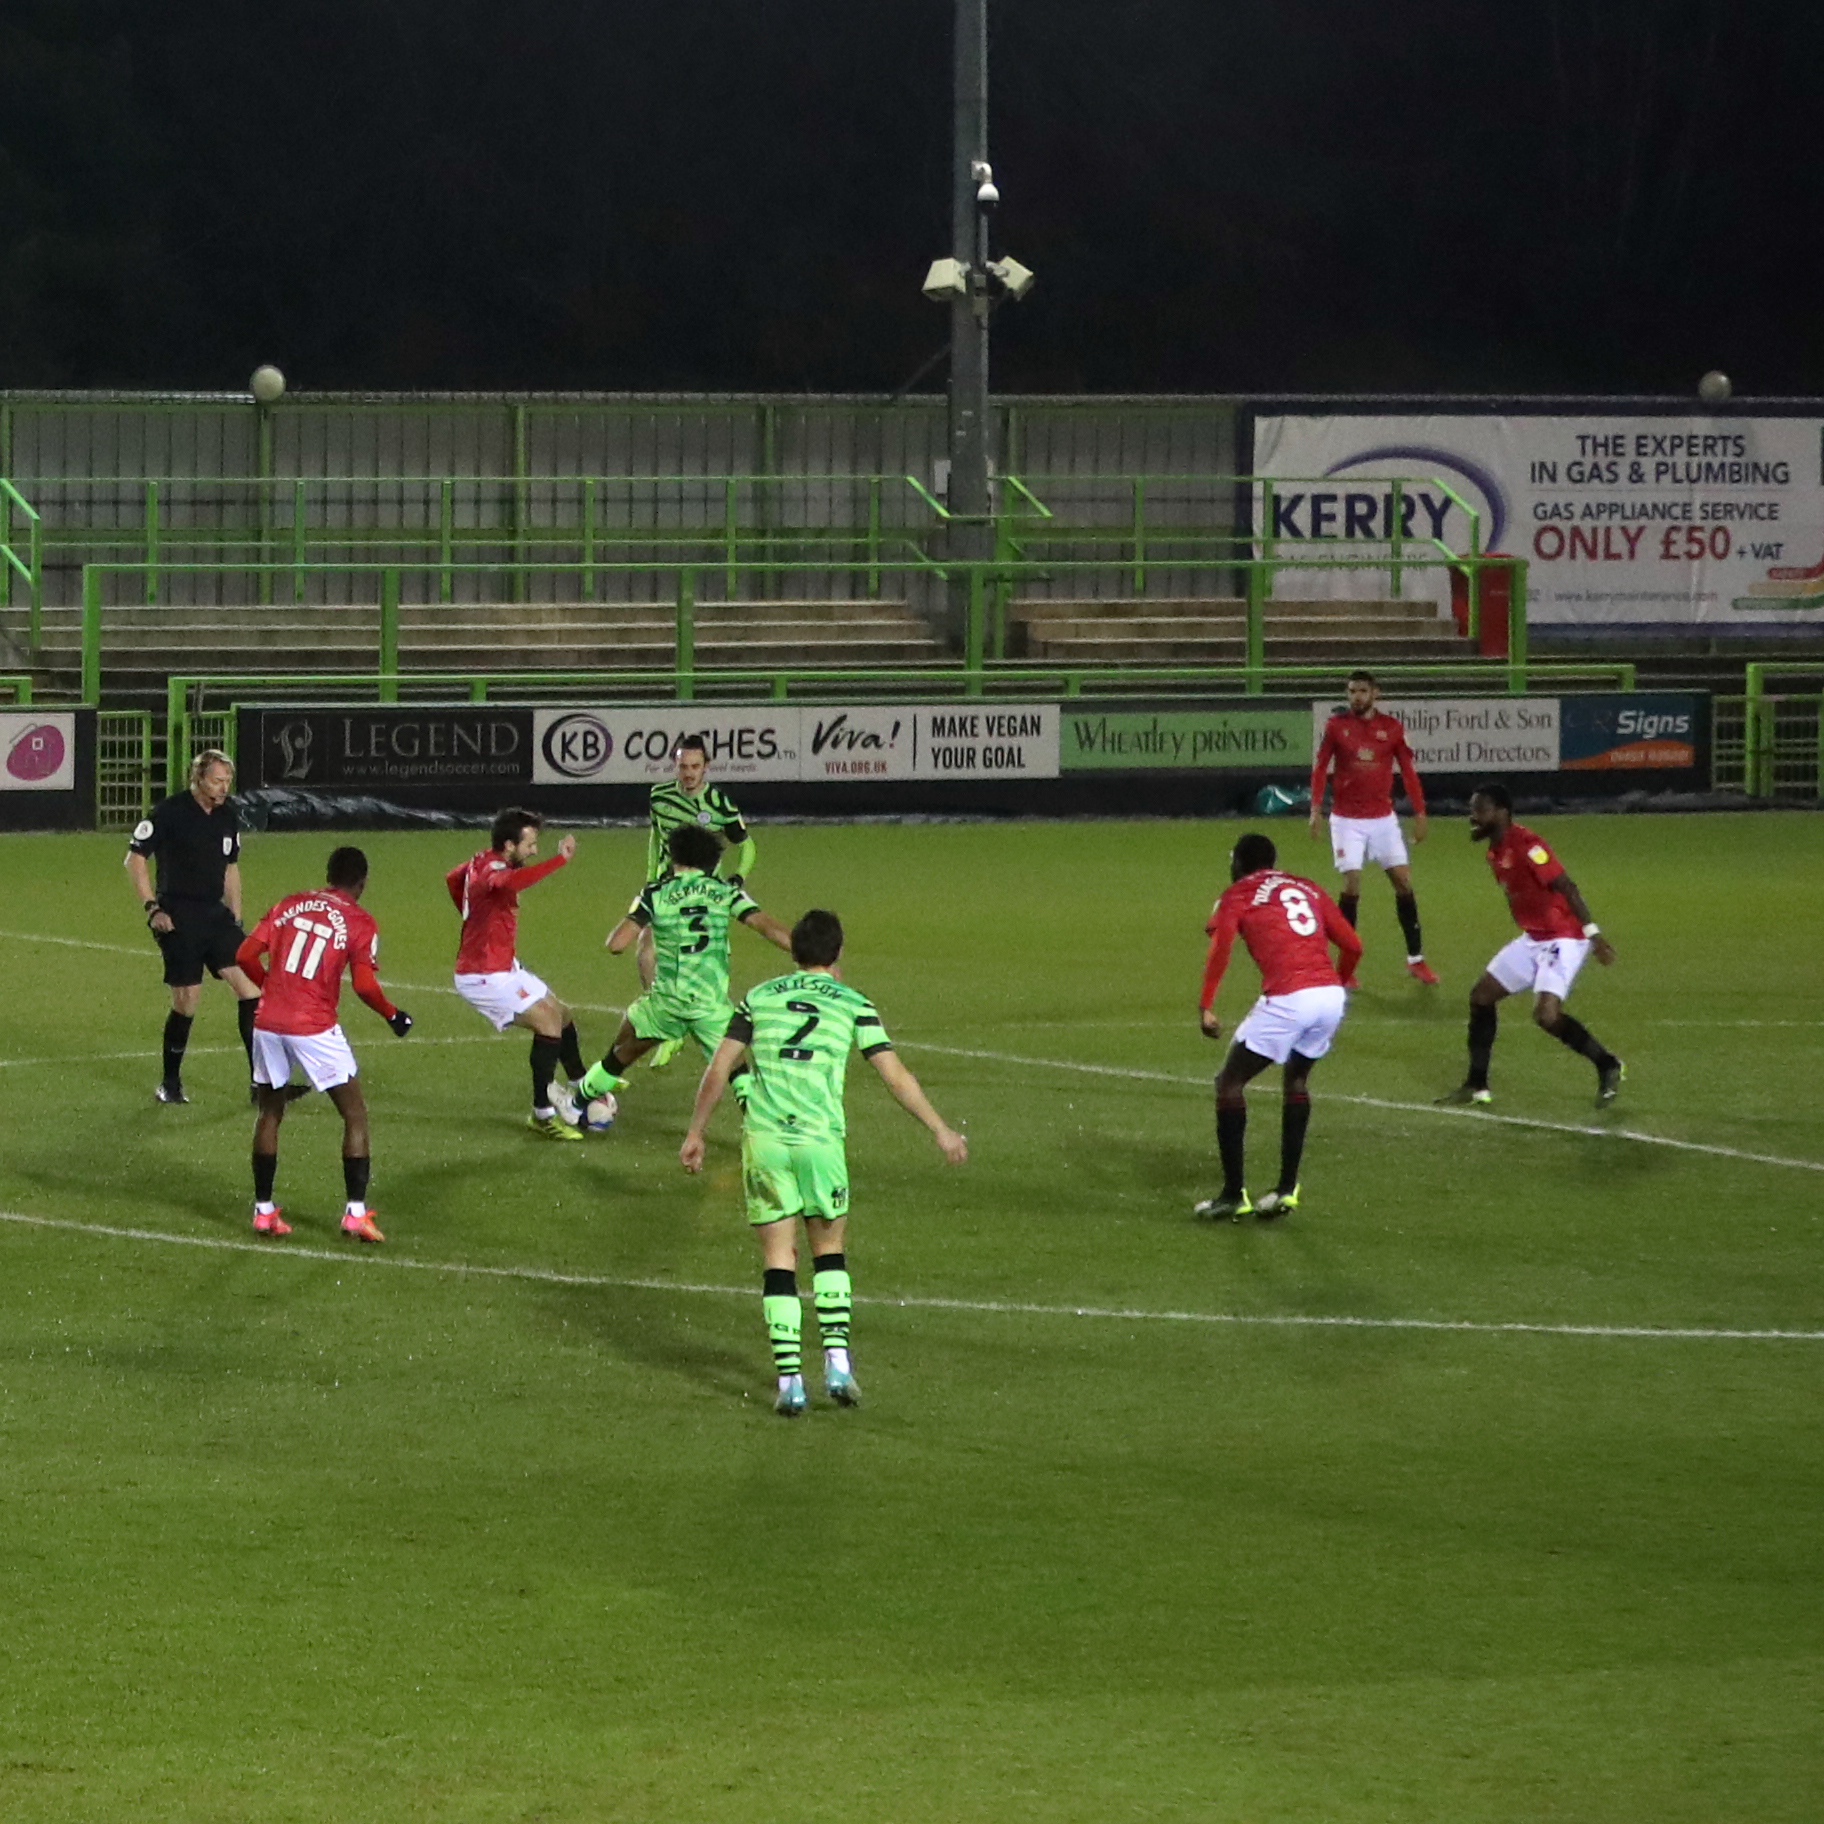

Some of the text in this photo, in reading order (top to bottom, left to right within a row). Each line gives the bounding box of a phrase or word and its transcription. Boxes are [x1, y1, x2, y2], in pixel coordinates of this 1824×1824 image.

[1578, 435, 1746, 457] THE EXPERTS
[1530, 462, 1790, 485] IN GAS & PLUMBING
[1274, 492, 1452, 539] KERRY
[1533, 502, 1779, 521] GAS APPLIANCE SERVICE
[1533, 525, 1645, 562] ONLY
[1660, 525, 1731, 561] £50
[1753, 543, 1784, 560] VAT
[931, 715, 1041, 738] MAKE VEGAN
[1446, 709, 1492, 730] Ford
[1495, 710, 1510, 729] &
[1516, 711, 1552, 729] Son
[1616, 709, 1691, 739] Signs
[560, 728, 796, 763] KB COAHES LTD
[811, 714, 901, 755] Viva!
[931, 746, 1026, 769] YOUR GOAL
[1413, 740, 1551, 763] neral Directors
[342, 760, 520, 777] www.legendsoccer.com
[825, 761, 888, 774] VIVA.ORG.UK
[1279, 887, 1317, 937] 8
[679, 905, 710, 955] 3
[284, 916, 334, 981] 11
[773, 977, 842, 1000] WILSON
[778, 1000, 820, 1062] 2
